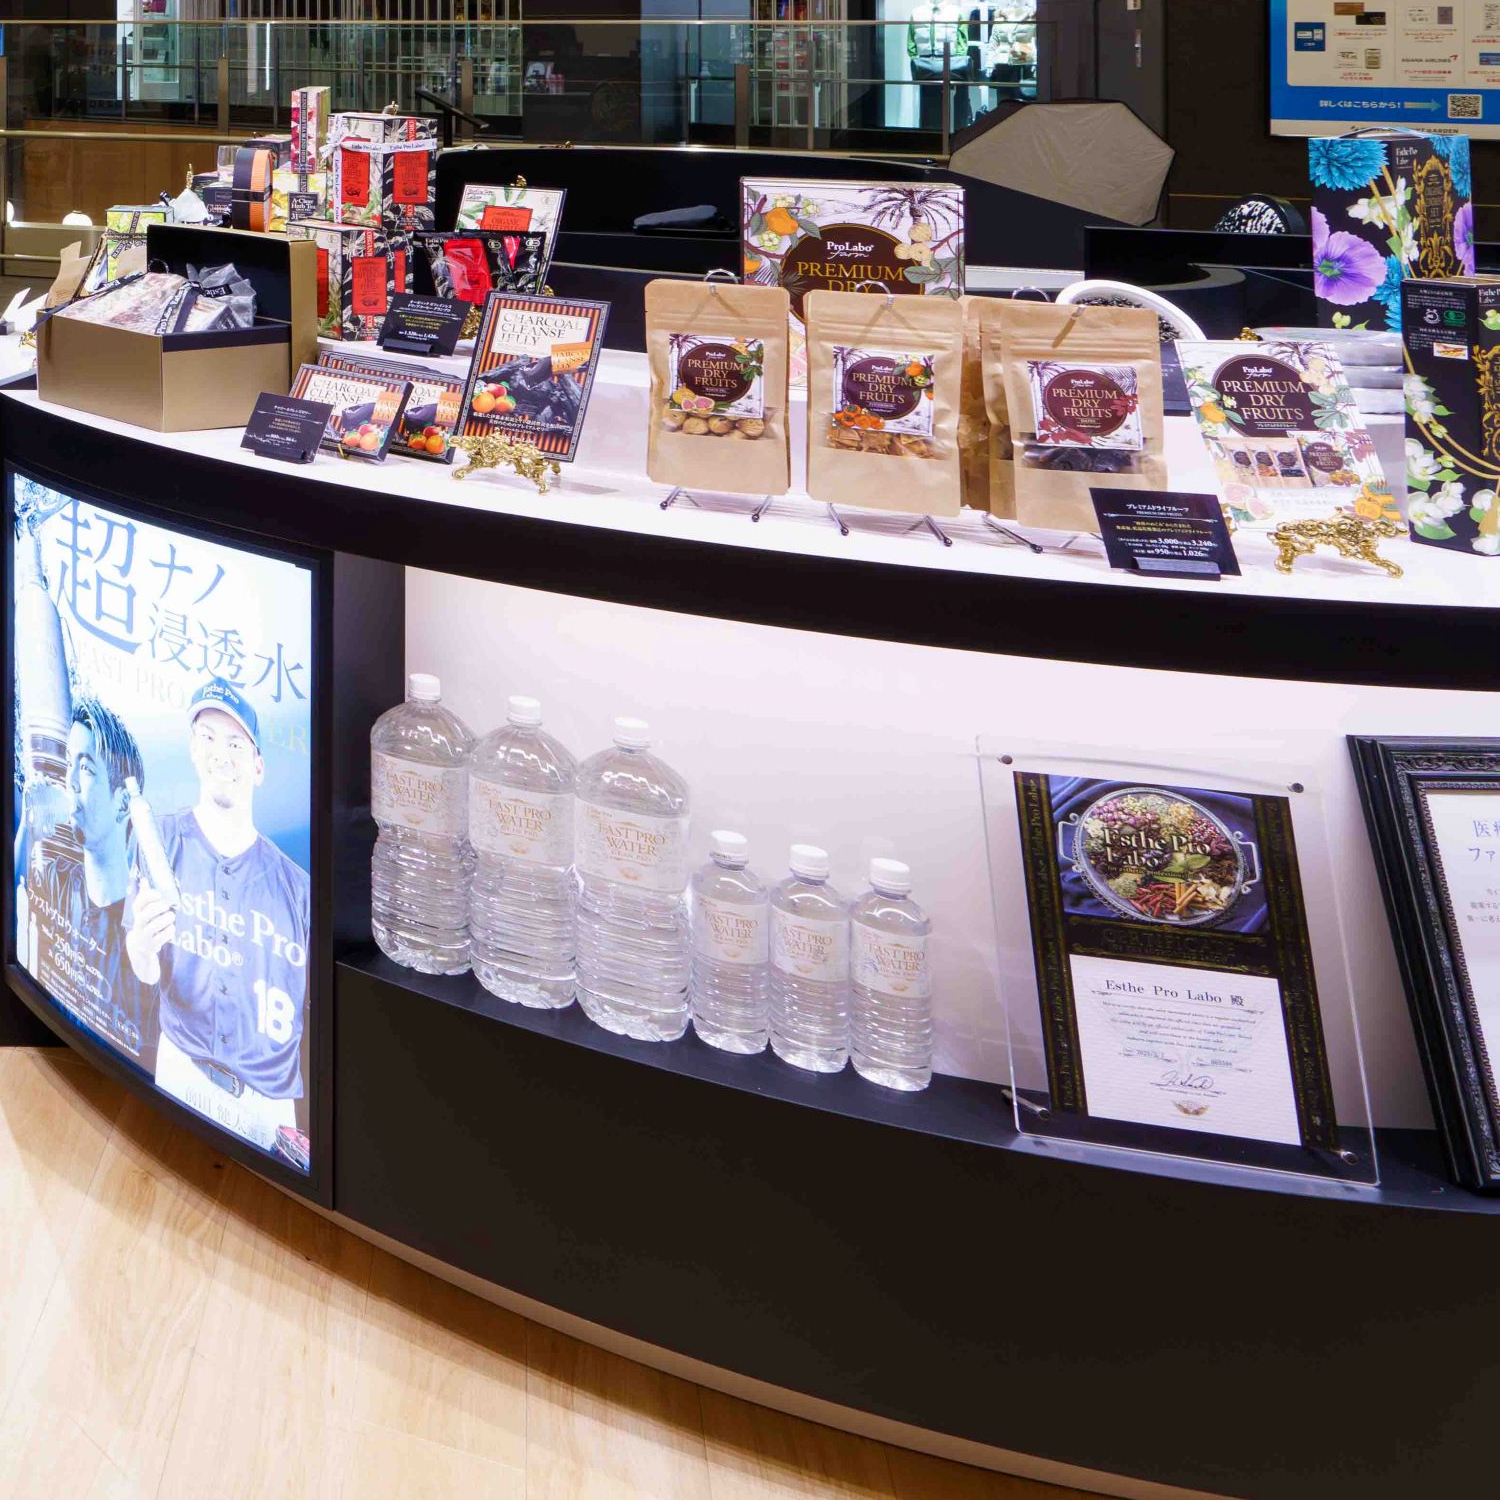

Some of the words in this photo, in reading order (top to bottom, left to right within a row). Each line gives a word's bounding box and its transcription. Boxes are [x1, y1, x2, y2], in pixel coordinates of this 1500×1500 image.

[826, 241, 875, 252] ProLabo
[797, 261, 905, 280] PREMIUM
[503, 312, 583, 331] CHARCOAL
[501, 323, 566, 339] CLEANSE
[501, 332, 541, 346] JELLY
[687, 359, 744, 371] PREMIUM
[703, 368, 729, 379] DRY
[694, 377, 738, 389] FRUITS
[852, 372, 915, 386] PREMIUM
[1222, 380, 1306, 394] PREMIUM
[309, 388, 362, 404] CLEANSE
[313, 379, 377, 397] CHARCOAL
[868, 382, 895, 394] DRY
[1052, 388, 1118, 400] PREMIUM
[859, 391, 905, 404] FRUITS
[1072, 398, 1100, 408] DRY
[1249, 394, 1285, 407] DRY
[1063, 407, 1112, 418] FRUITS
[1241, 407, 1304, 421] FRUITS
[56, 500, 142, 655] 超
[149, 543, 226, 605] ナノ
[148, 602, 308, 703] 浸透水
[387, 772, 414, 788] FAST
[418, 778, 443, 793] PRO
[392, 785, 435, 803] WATER
[489, 799, 518, 816] FAST
[524, 806, 551, 821] PRO
[495, 811, 544, 832] WATER
[600, 822, 631, 839] FAST
[636, 831, 667, 845] PRO
[1103, 828, 1166, 851] Esthe
[1172, 834, 1211, 856] Pro
[606, 836, 658, 857] WATER
[250, 909, 307, 967] Pro
[1105, 979, 1145, 994] Esthe
[1153, 985, 1179, 998] Pro
[1187, 989, 1222, 1004] Labo
[253, 978, 296, 1045] 18
